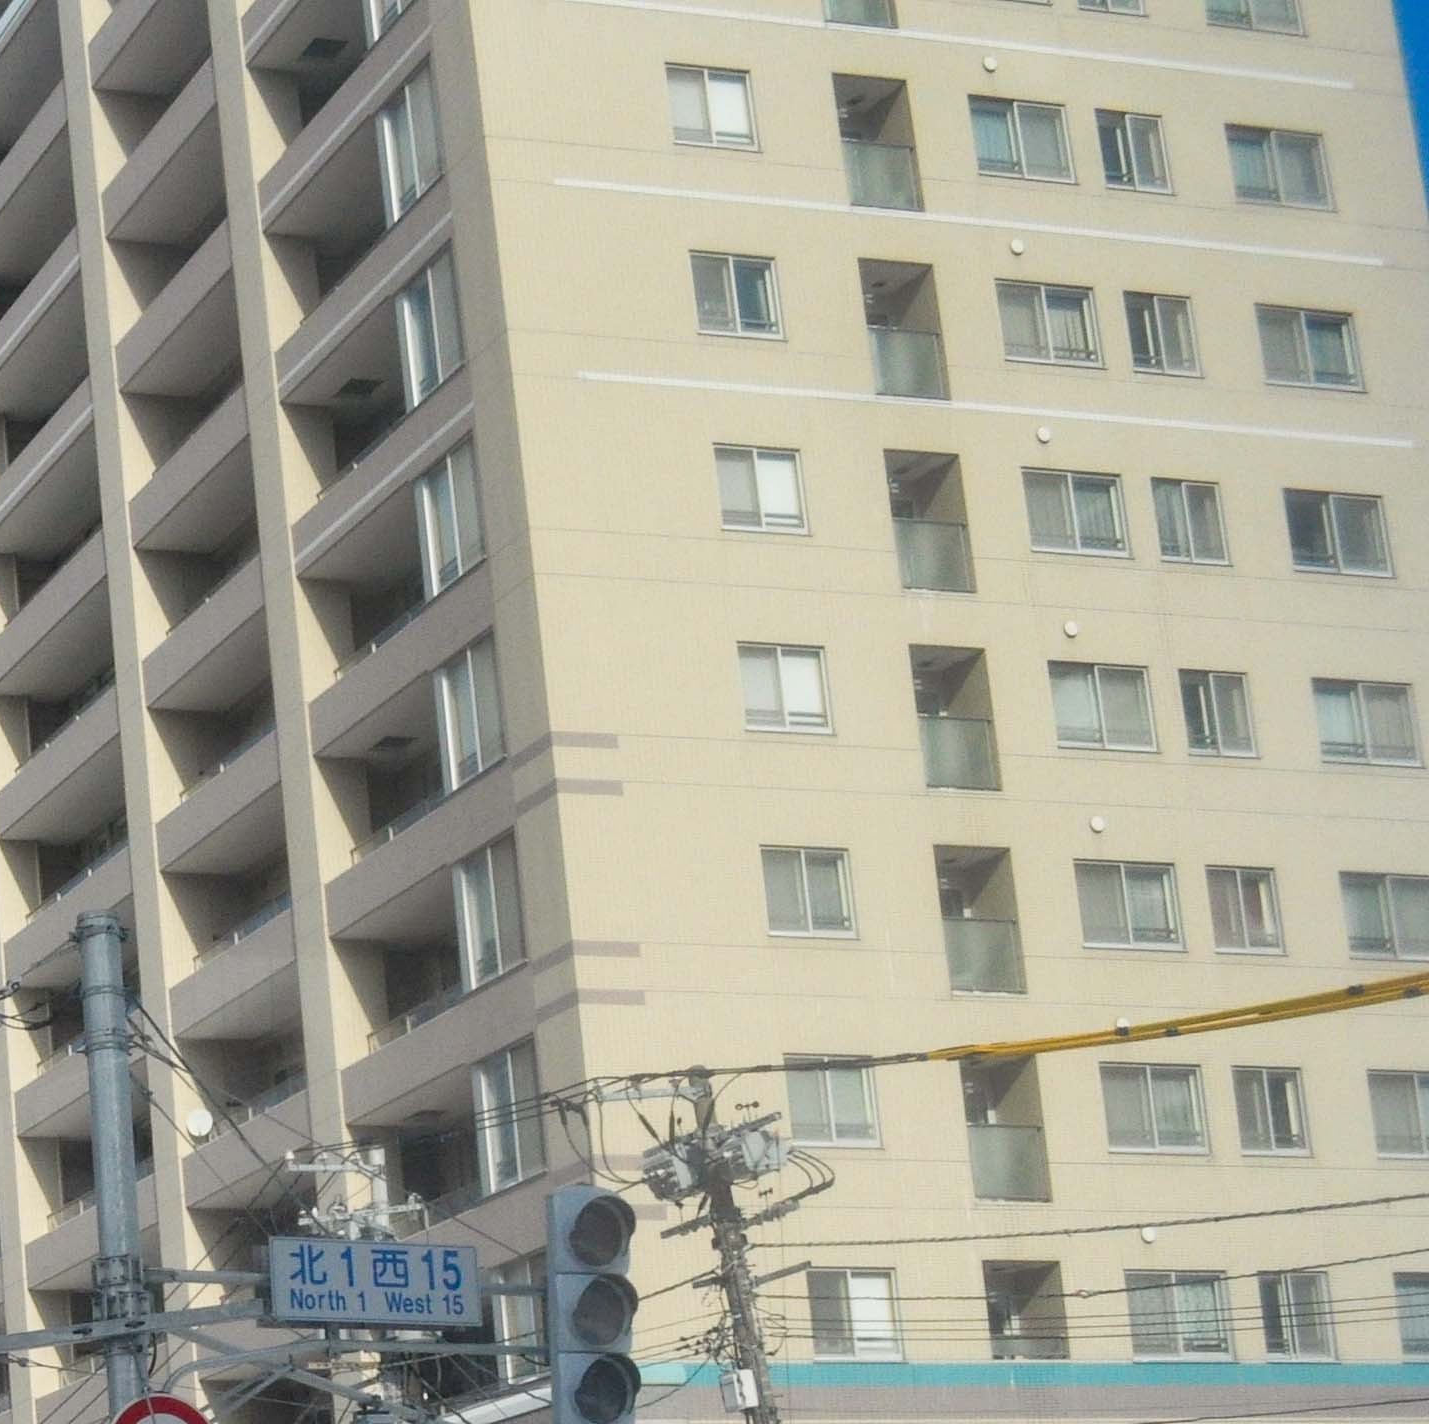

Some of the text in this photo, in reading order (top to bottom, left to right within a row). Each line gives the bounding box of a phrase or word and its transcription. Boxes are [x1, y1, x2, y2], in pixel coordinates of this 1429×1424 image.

[290, 1288, 465, 1316] North 1 West 15
